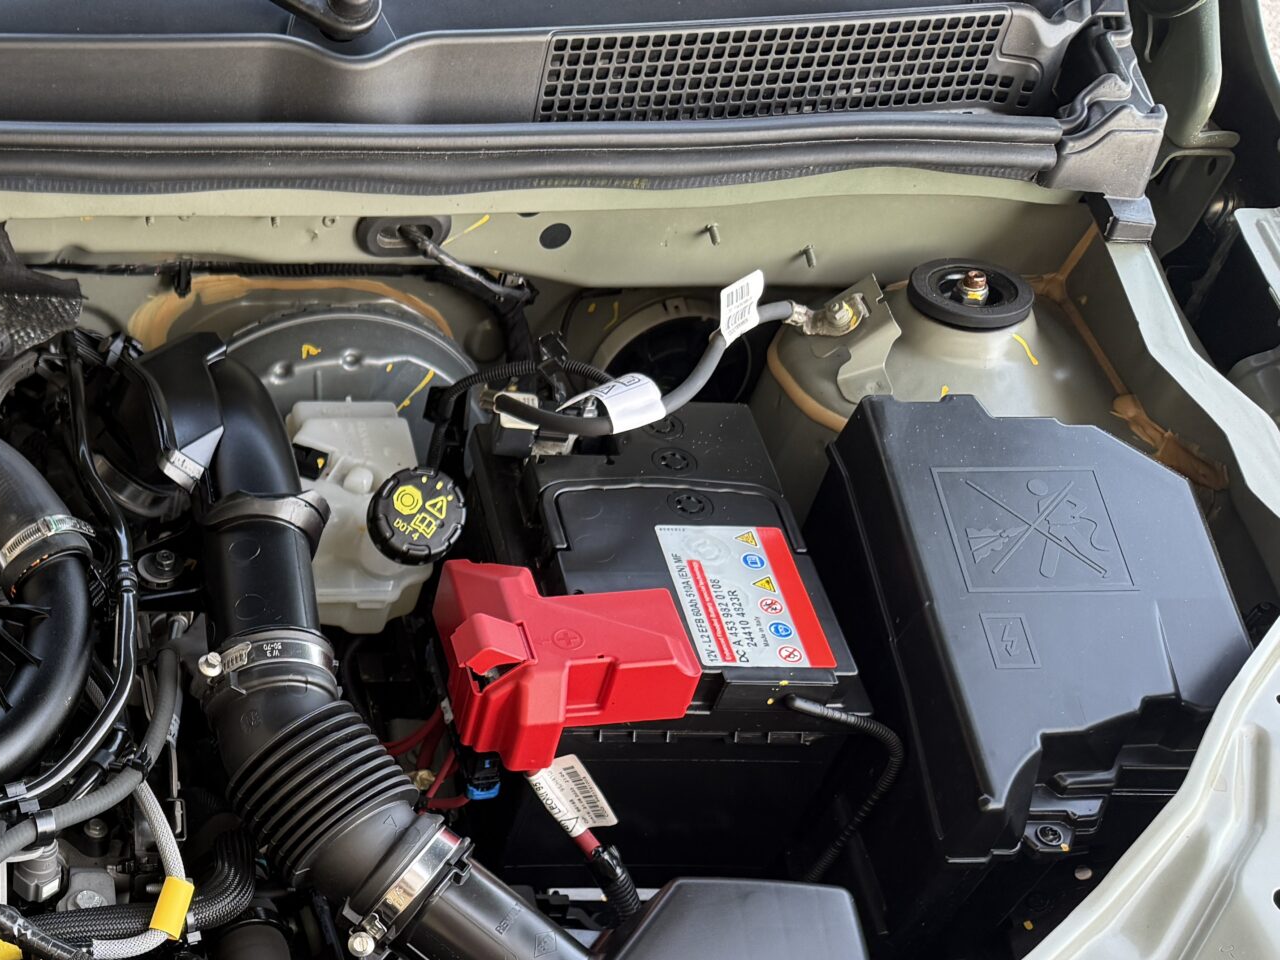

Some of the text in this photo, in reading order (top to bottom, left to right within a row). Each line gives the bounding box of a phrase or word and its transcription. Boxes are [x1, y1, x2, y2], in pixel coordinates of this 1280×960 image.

[393, 518, 420, 541] DOT 4
[671, 553, 682, 562] MF
[675, 565, 690, 578] (EN)
[681, 580, 695, 596] 510A
[687, 599, 702, 616] 60Ah
[694, 618, 708, 632] EFB
[724, 621, 739, 636] 453
[700, 634, 712, 643] L2
[738, 620, 757, 646] 24410
[705, 649, 718, 661] 12V
